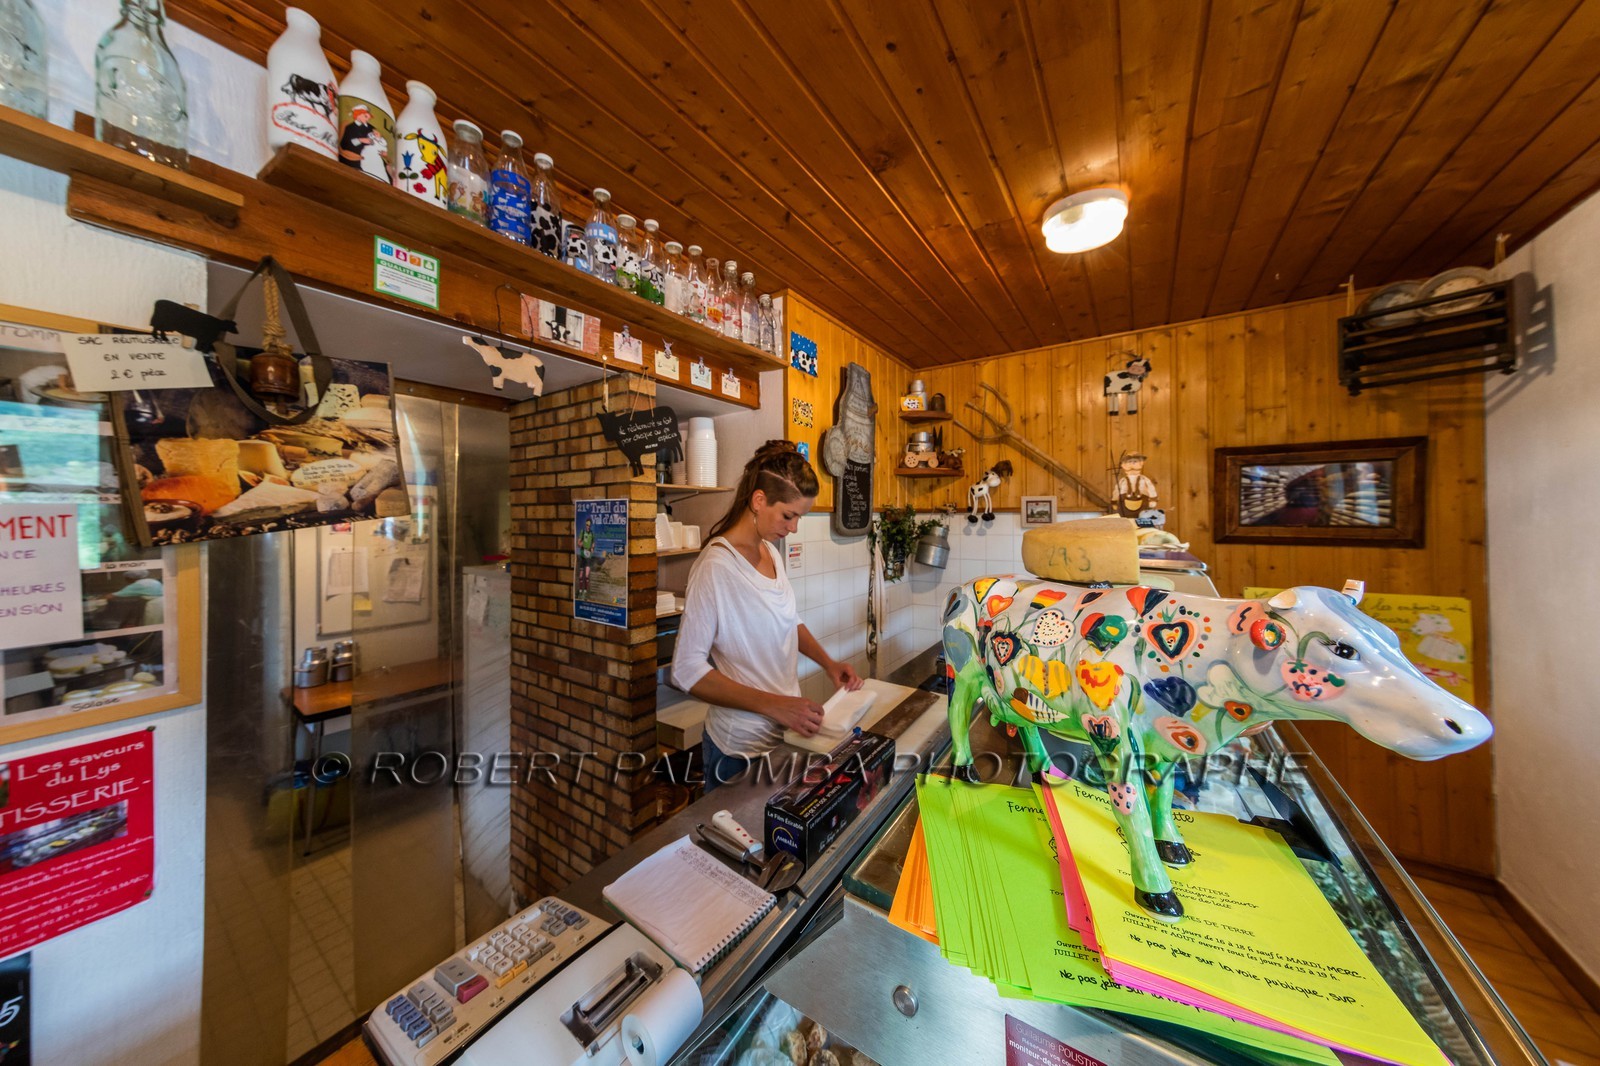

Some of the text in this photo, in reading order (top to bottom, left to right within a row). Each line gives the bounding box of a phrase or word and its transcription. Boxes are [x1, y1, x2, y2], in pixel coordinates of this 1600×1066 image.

[0, 326, 60, 343] TOMM
[78, 337, 102, 346] SAC
[104, 352, 166, 362] EN VENTE
[111, 370, 120, 379] 2
[590, 502, 611, 513] Trail
[613, 502, 627, 513] du
[590, 514, 602, 525] Val
[0, 514, 73, 541] MENT
[0, 549, 36, 559] NCE
[0, 582, 66, 595] HEURES
[0, 603, 63, 617] ENSION
[18, 741, 145, 781] Les saveurs
[45, 761, 121, 788] du Lys
[0, 777, 139, 829] TISSERIE
[774, 812, 784, 823] Film
[1172, 811, 1194, 823] tte
[1183, 914, 1256, 938] MES DE TERRE
[1056, 940, 1082, 951] Ouvert
[1122, 915, 1158, 931] JUILLET
[1170, 930, 1196, 944] AOUT
[1198, 940, 1225, 953] ouvert
[1227, 946, 1244, 959] tous
[1246, 950, 1257, 962] les
[1259, 955, 1282, 969] jours
[1284, 962, 1294, 971] de
[1308, 968, 1315, 976] à
[1125, 910, 1151, 923] Ouvert
[1152, 918, 1169, 929] tous
[1171, 922, 1180, 932] les
[1181, 927, 1201, 939] jours
[1204, 933, 1214, 941] de
[1216, 937, 1225, 945] 16
[1256, 948, 1275, 960] sauf
[1276, 951, 1284, 961] le
[1286, 955, 1326, 972] MARDI,
[1054, 948, 1090, 961] JUILLET
[1129, 933, 1143, 944] Ne
[1146, 938, 1167, 951] pas
[1169, 944, 1193, 959] jeter
[1195, 956, 1215, 967] sur
[1219, 961, 1235, 973] la
[1236, 968, 1261, 981] voie
[1264, 976, 1330, 1001] publique,
[1060, 969, 1075, 981] Ne
[1077, 974, 1098, 985] pas
[1100, 975, 1122, 991] jeter
[1015, 1023, 1056, 1051] Guillaume
[1009, 1039, 1061, 1066] moniteur-de-
